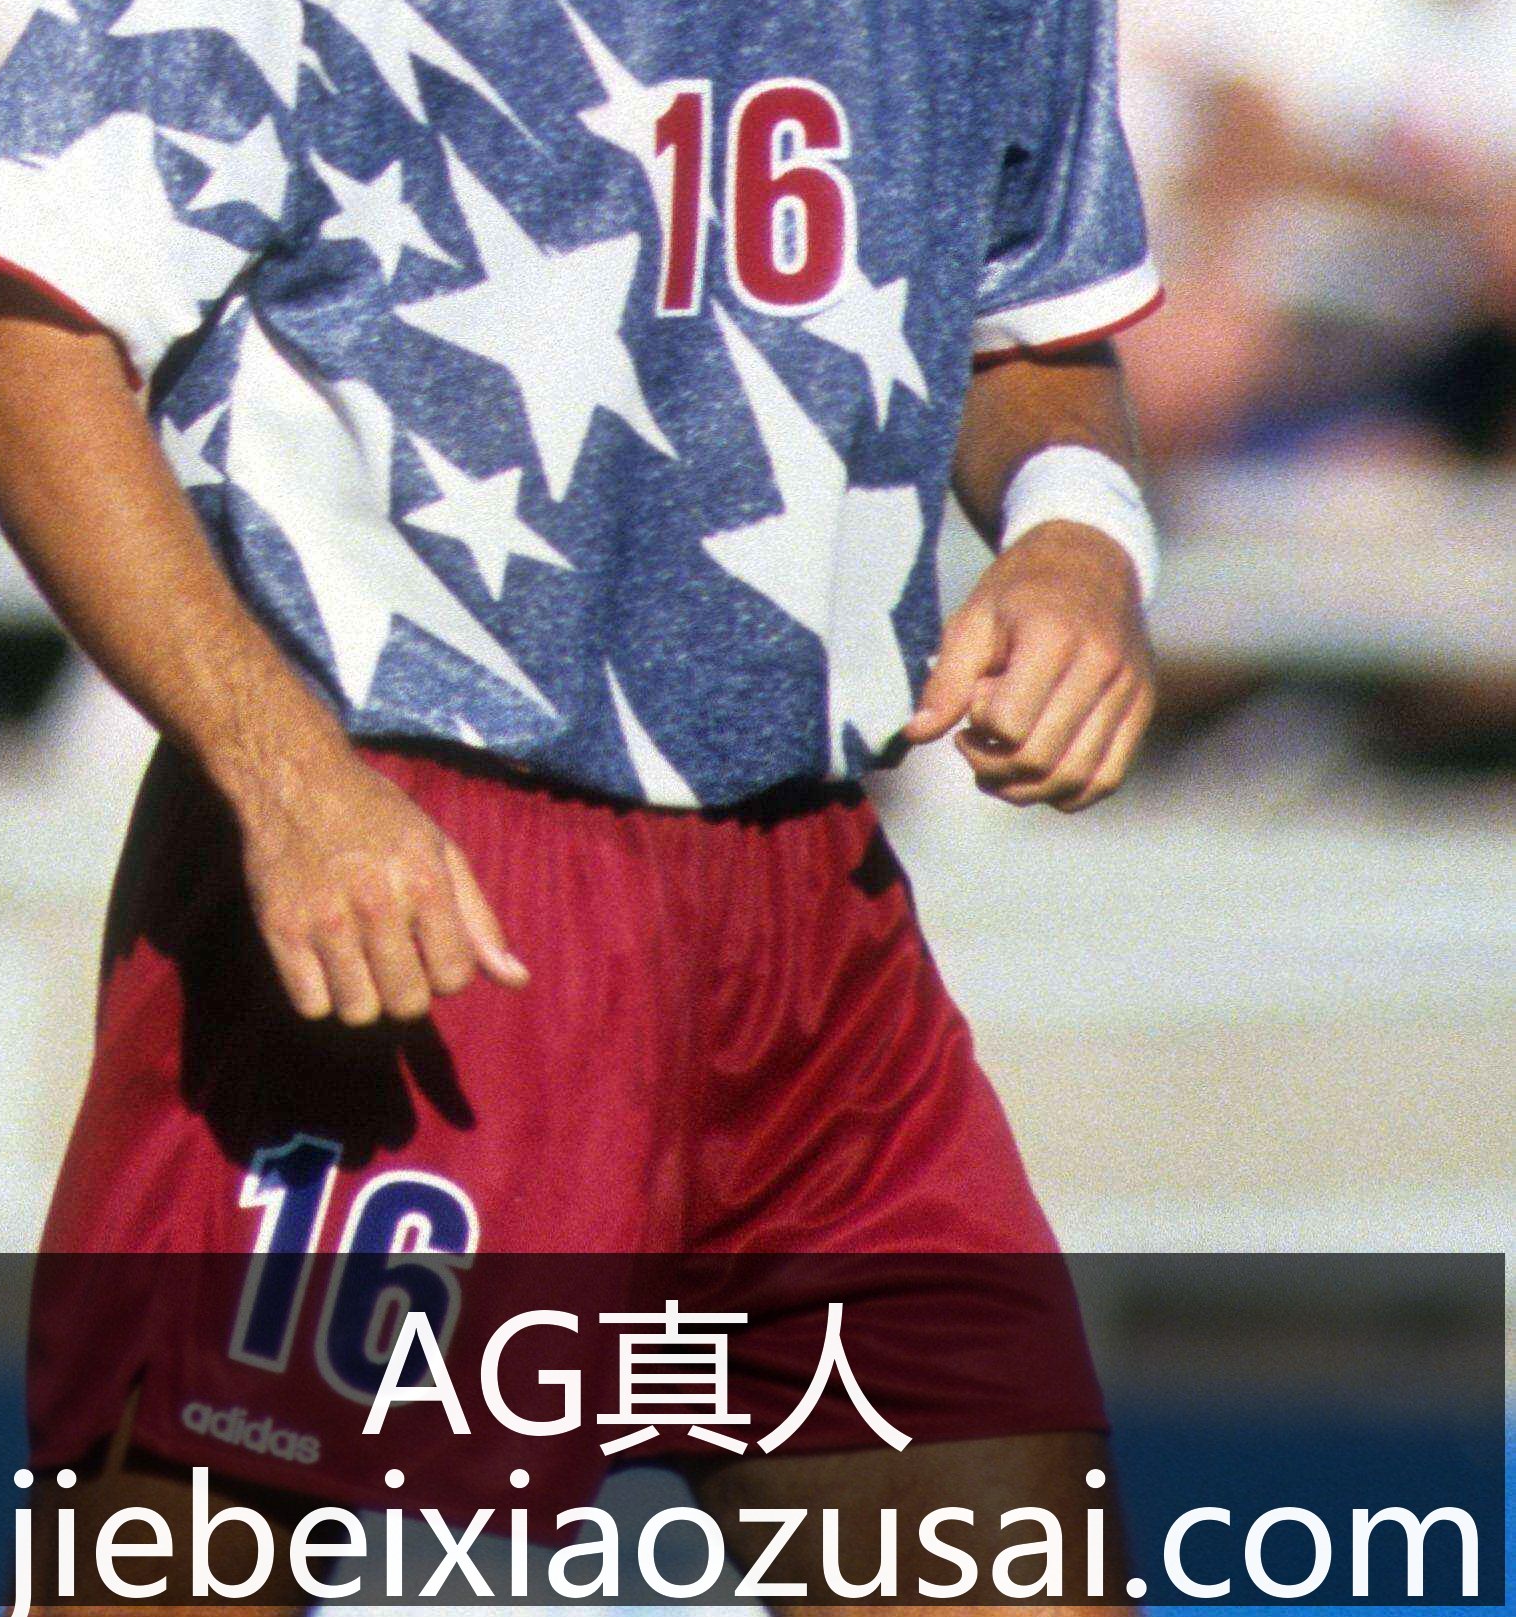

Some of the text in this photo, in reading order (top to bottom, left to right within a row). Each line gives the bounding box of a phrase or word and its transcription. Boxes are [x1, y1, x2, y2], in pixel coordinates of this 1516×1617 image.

[654, 76, 858, 318] 16
[228, 1133, 482, 1408] 16
[181, 1401, 321, 1465] adidas
